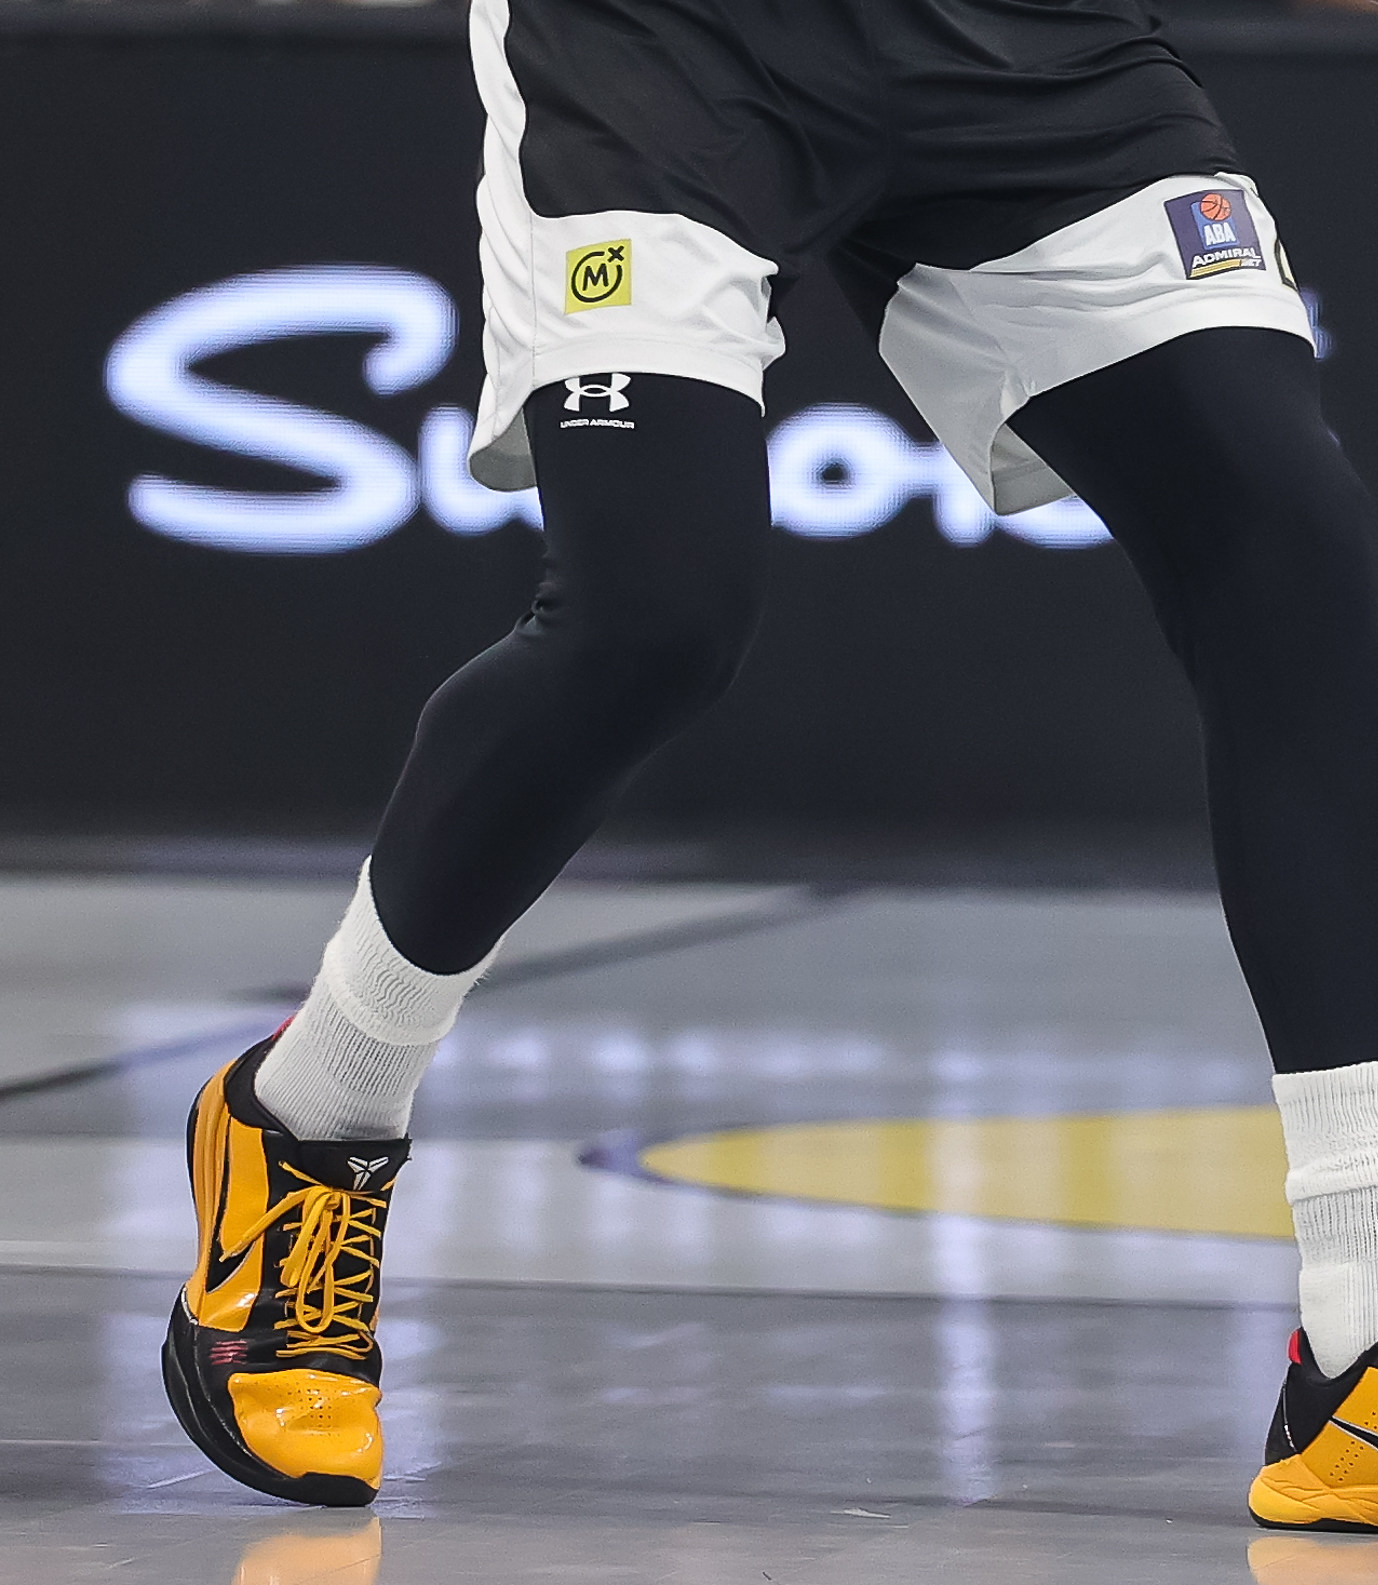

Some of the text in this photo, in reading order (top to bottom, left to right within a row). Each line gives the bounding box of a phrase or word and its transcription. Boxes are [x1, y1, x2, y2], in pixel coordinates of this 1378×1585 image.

[1203, 221, 1237, 247] ABA
[1191, 247, 1262, 268] ADMIRAL
[560, 418, 635, 430] UNDER ARMOUR
